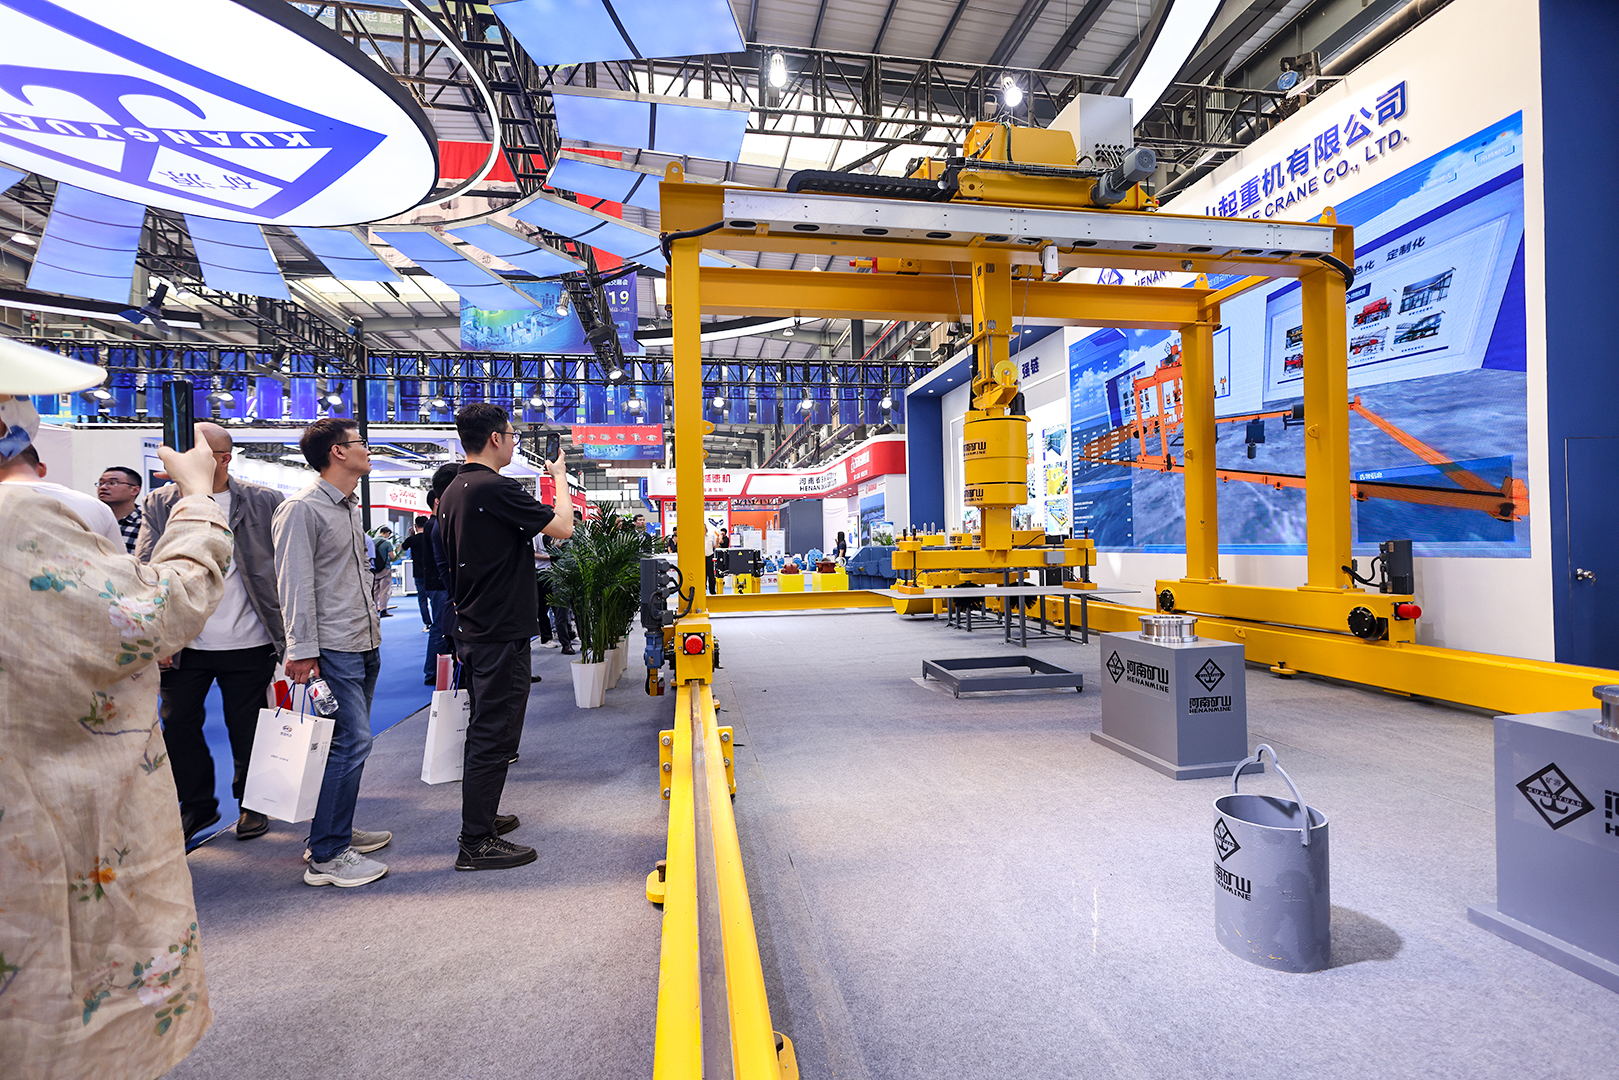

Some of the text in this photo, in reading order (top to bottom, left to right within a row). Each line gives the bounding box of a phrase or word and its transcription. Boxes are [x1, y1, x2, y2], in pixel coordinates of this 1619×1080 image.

[1264, 176, 1319, 218] CRANE
[1365, 129, 1409, 162] LTD.
[1386, 236, 1426, 261] 定制化
[609, 290, 630, 305] 19
[1022, 356, 1039, 379] 强链
[1127, 660, 1169, 685] 河南矿山
[1126, 675, 1169, 693] HENANMINE
[1189, 696, 1231, 708] 河南矿山
[1526, 786, 1583, 807] KUANGYUAN
